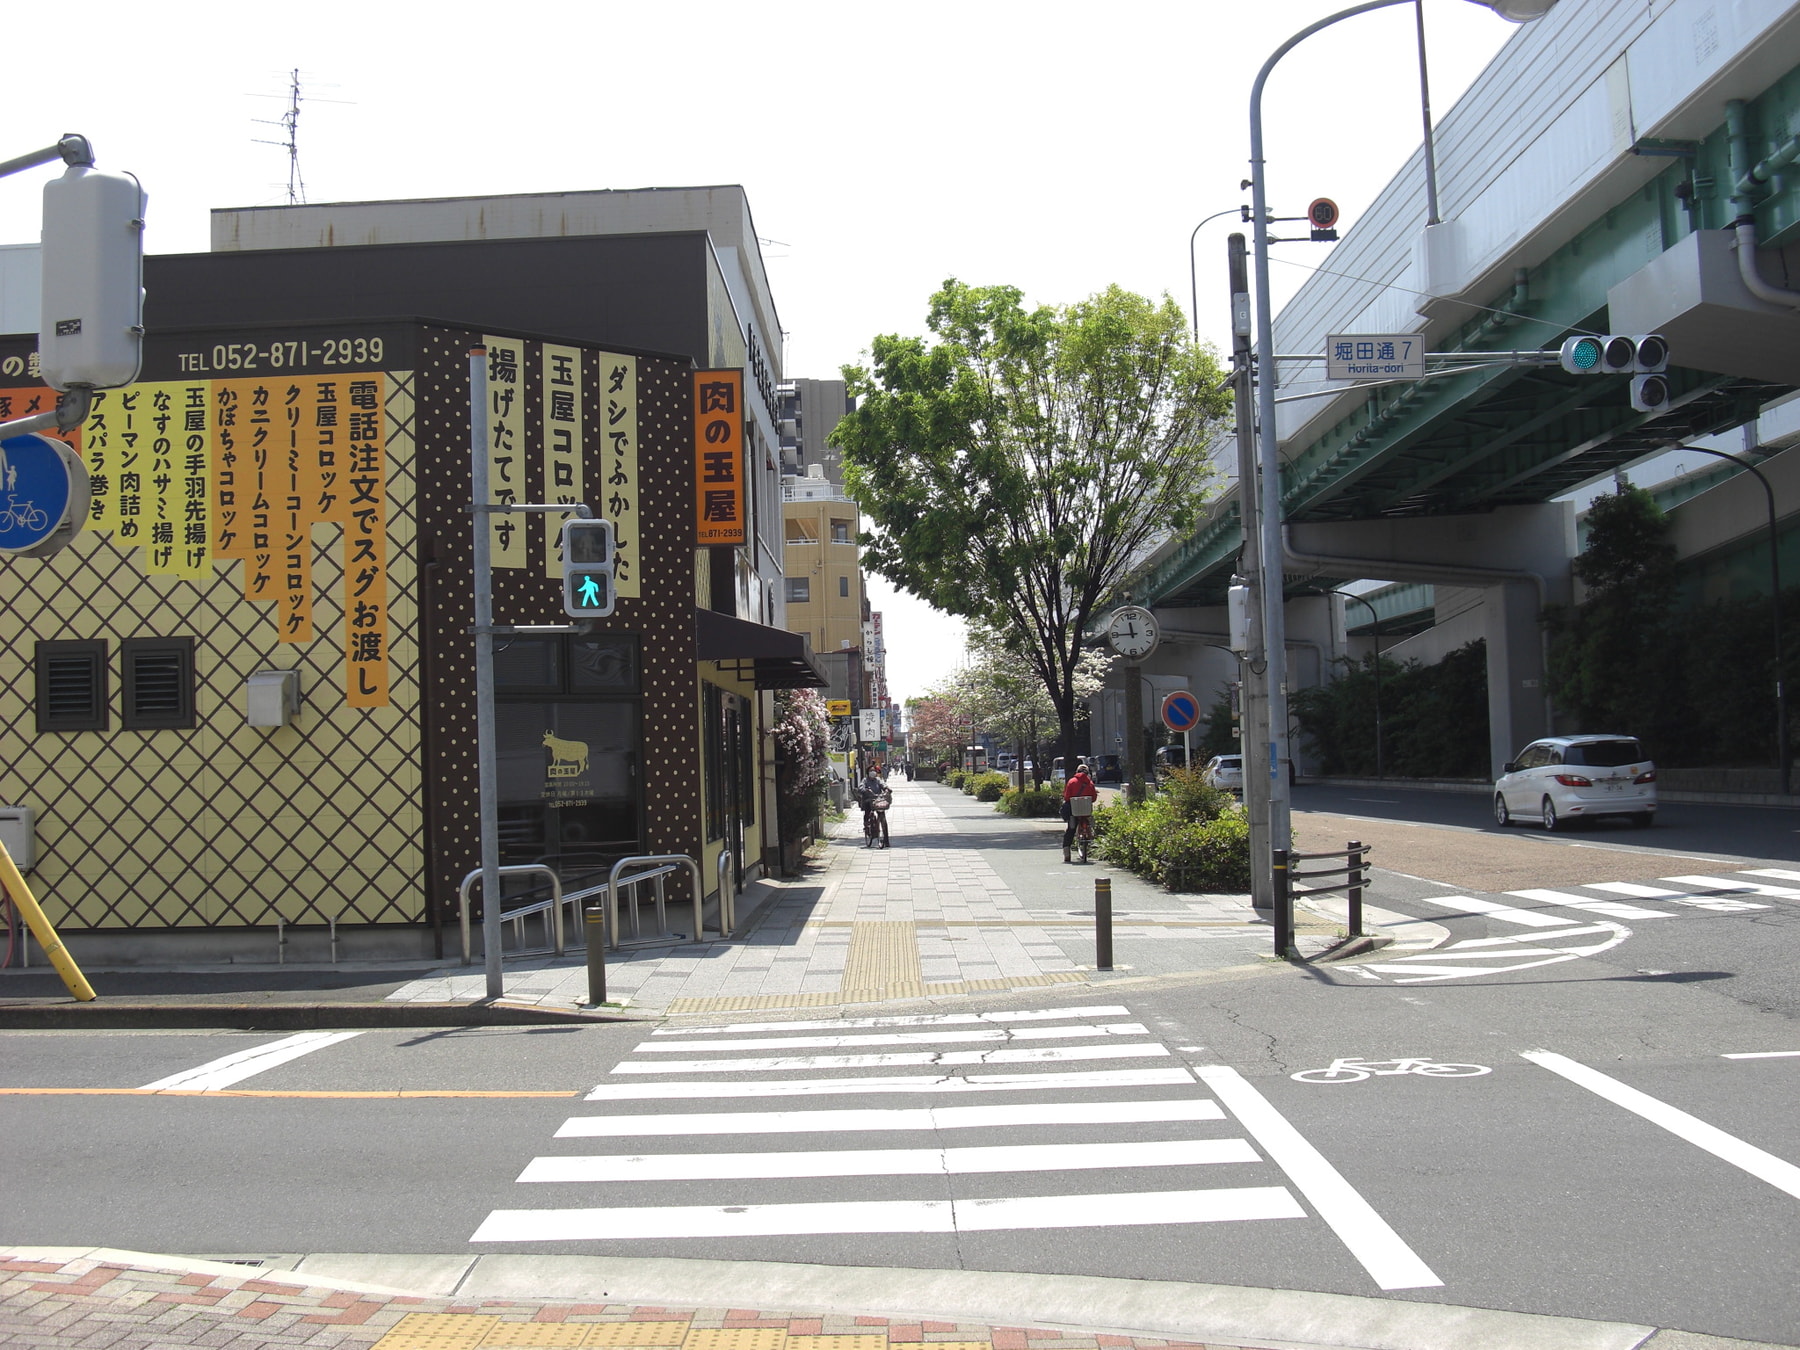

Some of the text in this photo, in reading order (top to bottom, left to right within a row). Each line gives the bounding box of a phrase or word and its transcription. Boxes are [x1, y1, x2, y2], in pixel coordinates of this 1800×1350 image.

[178, 337, 384, 372] TEL 052-871-2939
[1348, 363, 1404, 374] Horita-dori
[88, 392, 109, 521] アスパラ巻き
[120, 391, 141, 538] ピーマン肉詰め
[152, 391, 174, 569] なすのハサミ揚げ
[183, 387, 206, 569] 玉屋の手羽先揚げ
[217, 387, 239, 551] かぼちゃコロッケ
[250, 385, 271, 595] カニクリームコロッケ
[284, 384, 306, 635] クリーミーコーンコロッケ
[315, 382, 338, 515] 玉屋コロッケ
[488, 346, 518, 552] 揚げたてです
[608, 364, 630, 582] ダシでふかした
[700, 381, 737, 523] 肉の玉屋
[348, 380, 382, 696] 電話注文でスグお渡し
[709, 528, 743, 538] 871-2939
[1111, 631, 1119, 639] 9
[1125, 613, 1137, 621] 12
[1146, 629, 1154, 637] 3
